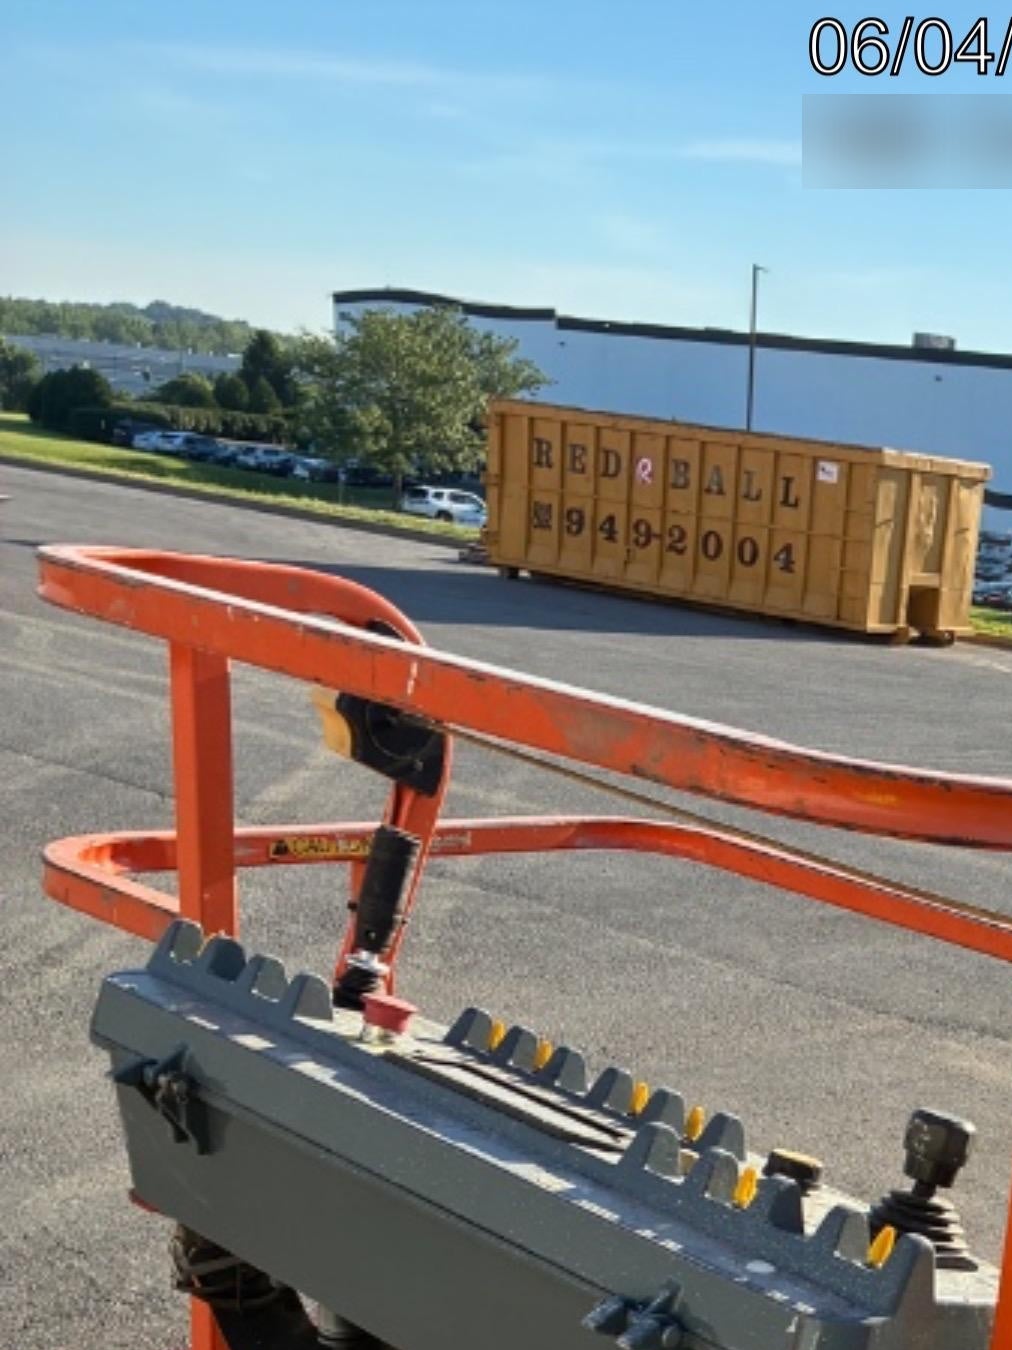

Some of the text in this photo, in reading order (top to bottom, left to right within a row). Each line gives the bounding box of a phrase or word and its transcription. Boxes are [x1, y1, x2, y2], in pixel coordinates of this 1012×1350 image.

[532, 437, 799, 508] RED BALL
[564, 507, 796, 574] 949-2004
